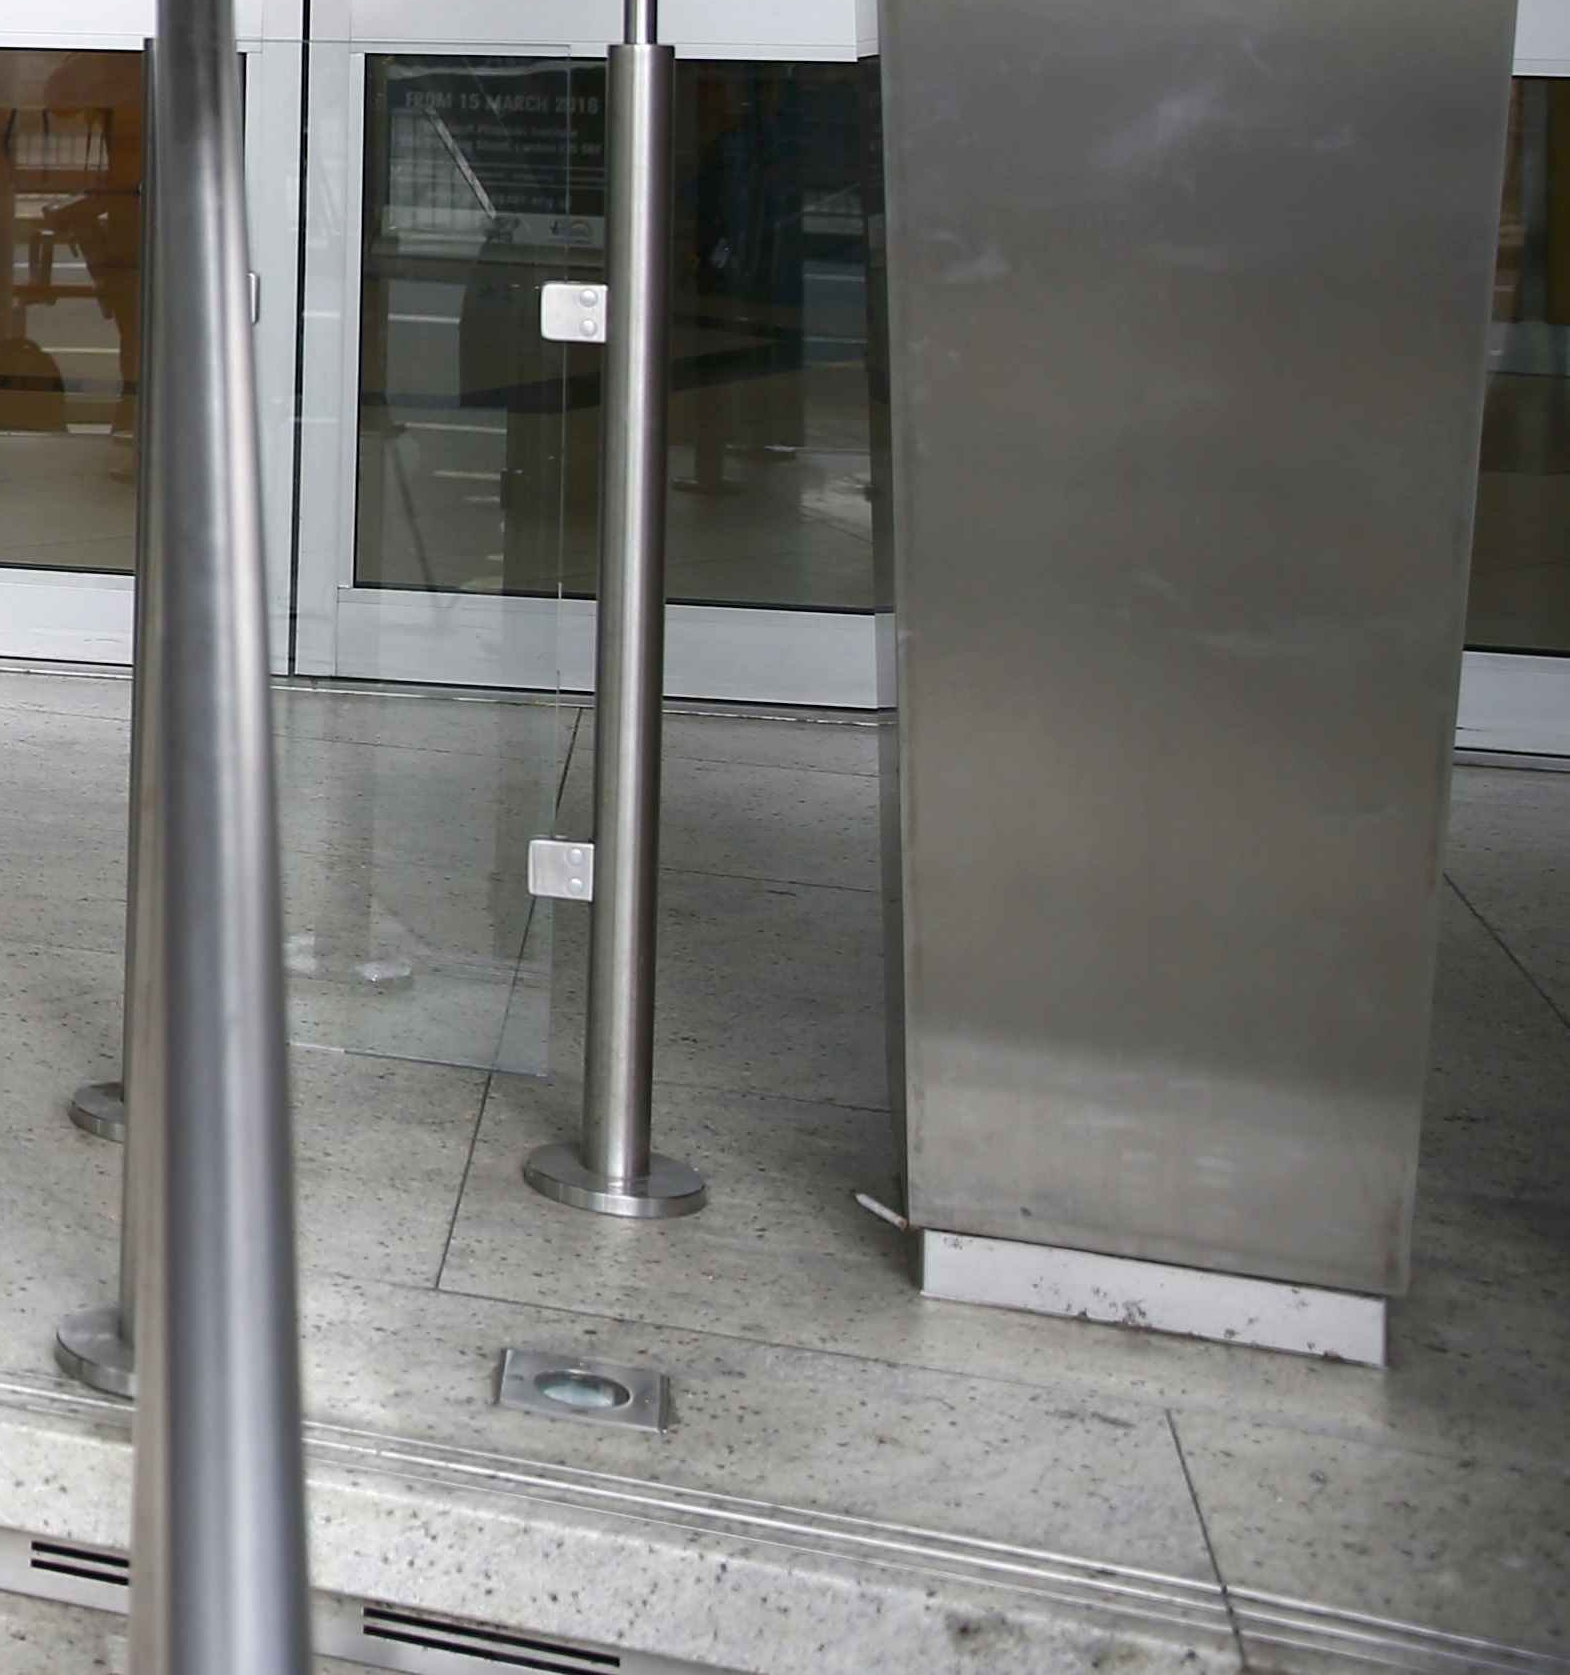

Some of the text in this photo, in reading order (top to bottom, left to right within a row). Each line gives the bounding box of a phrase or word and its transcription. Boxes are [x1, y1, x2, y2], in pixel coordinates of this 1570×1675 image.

[405, 91, 453, 109] FROM
[459, 92, 480, 109] 15
[485, 93, 549, 112] MARCH
